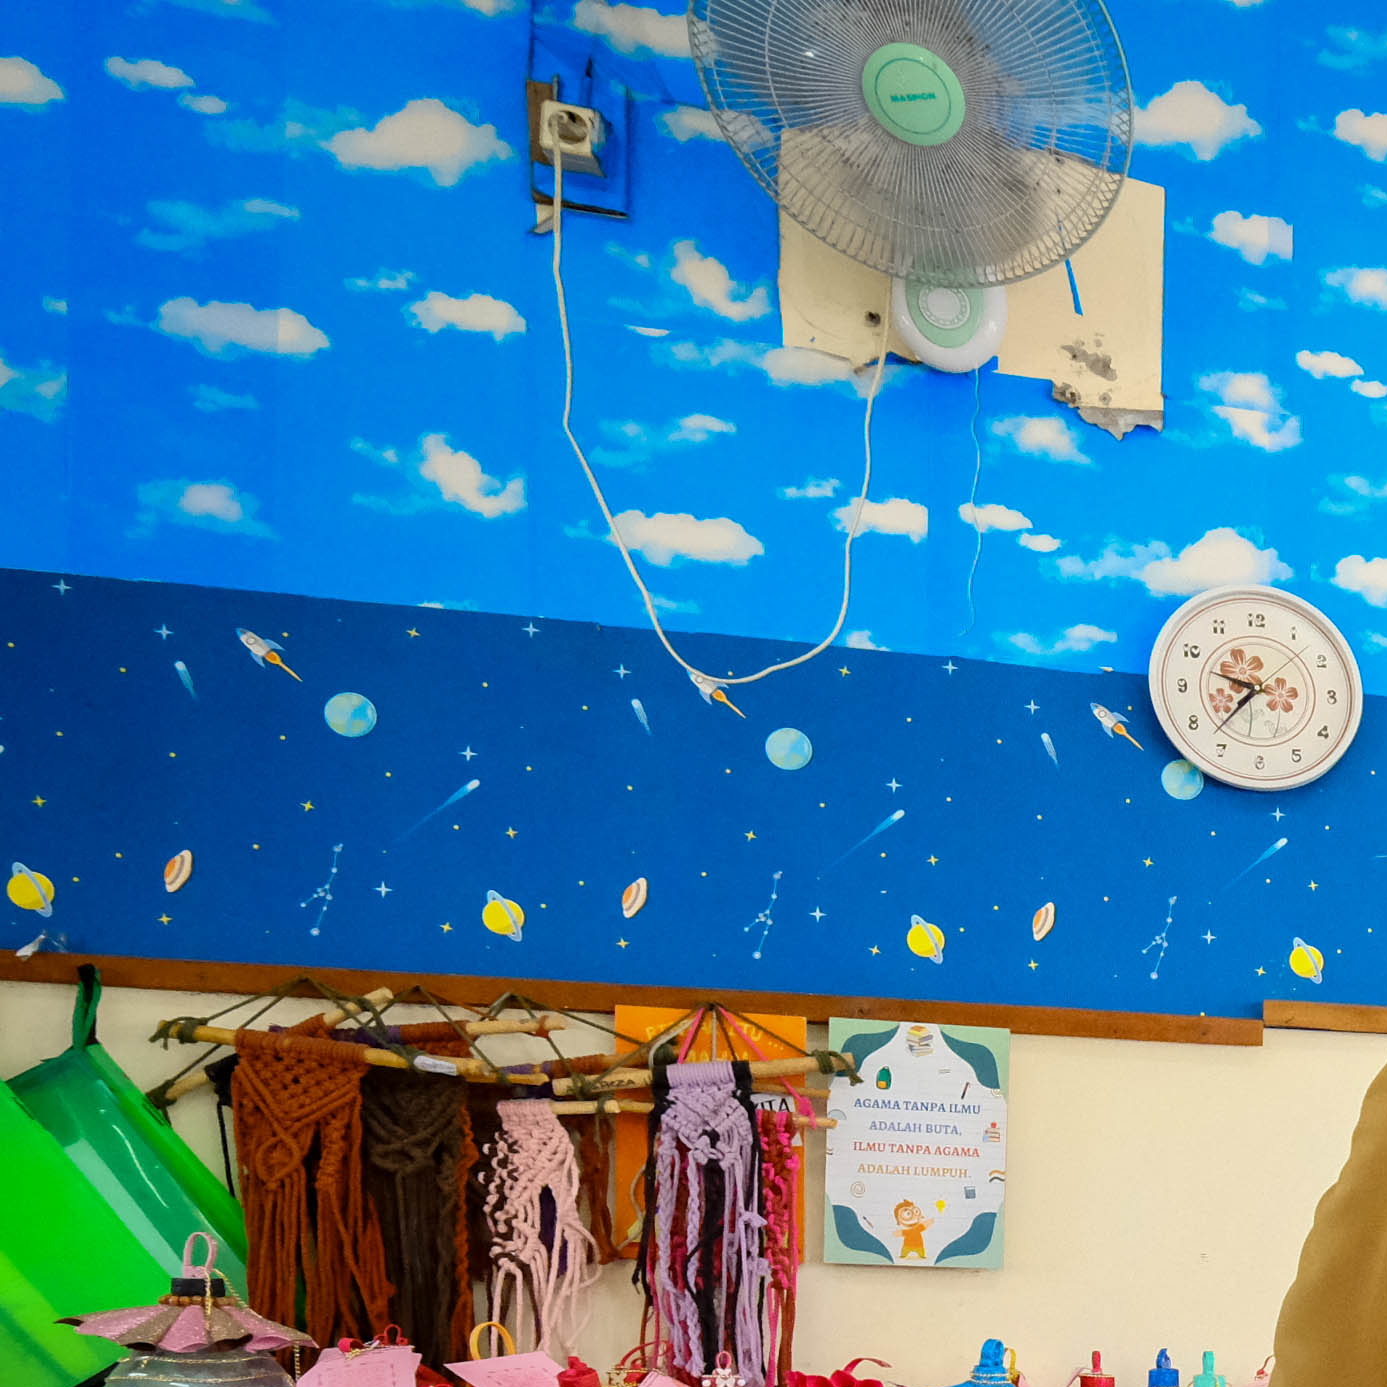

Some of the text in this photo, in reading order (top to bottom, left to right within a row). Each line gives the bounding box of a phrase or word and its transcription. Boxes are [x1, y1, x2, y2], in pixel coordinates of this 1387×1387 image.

[1248, 613, 1265, 628] 12
[1184, 644, 1200, 658] 10
[1317, 655, 1327, 668] 2
[1178, 679, 1187, 693] 9
[1327, 690, 1337, 704] 3
[1188, 715, 1199, 730] 8
[1317, 725, 1329, 739] 4
[1216, 743, 1227, 757] 7
[1291, 749, 1301, 763] 5
[1255, 755, 1265, 770] 6
[854, 1098, 981, 1115] AGAMA TANPA ILMU
[869, 1121, 962, 1136] ADALAH BUTA,
[853, 1141, 980, 1158] ILMU TANPA AGAMA
[857, 1163, 972, 1178] ADALAH LUMPUH.
